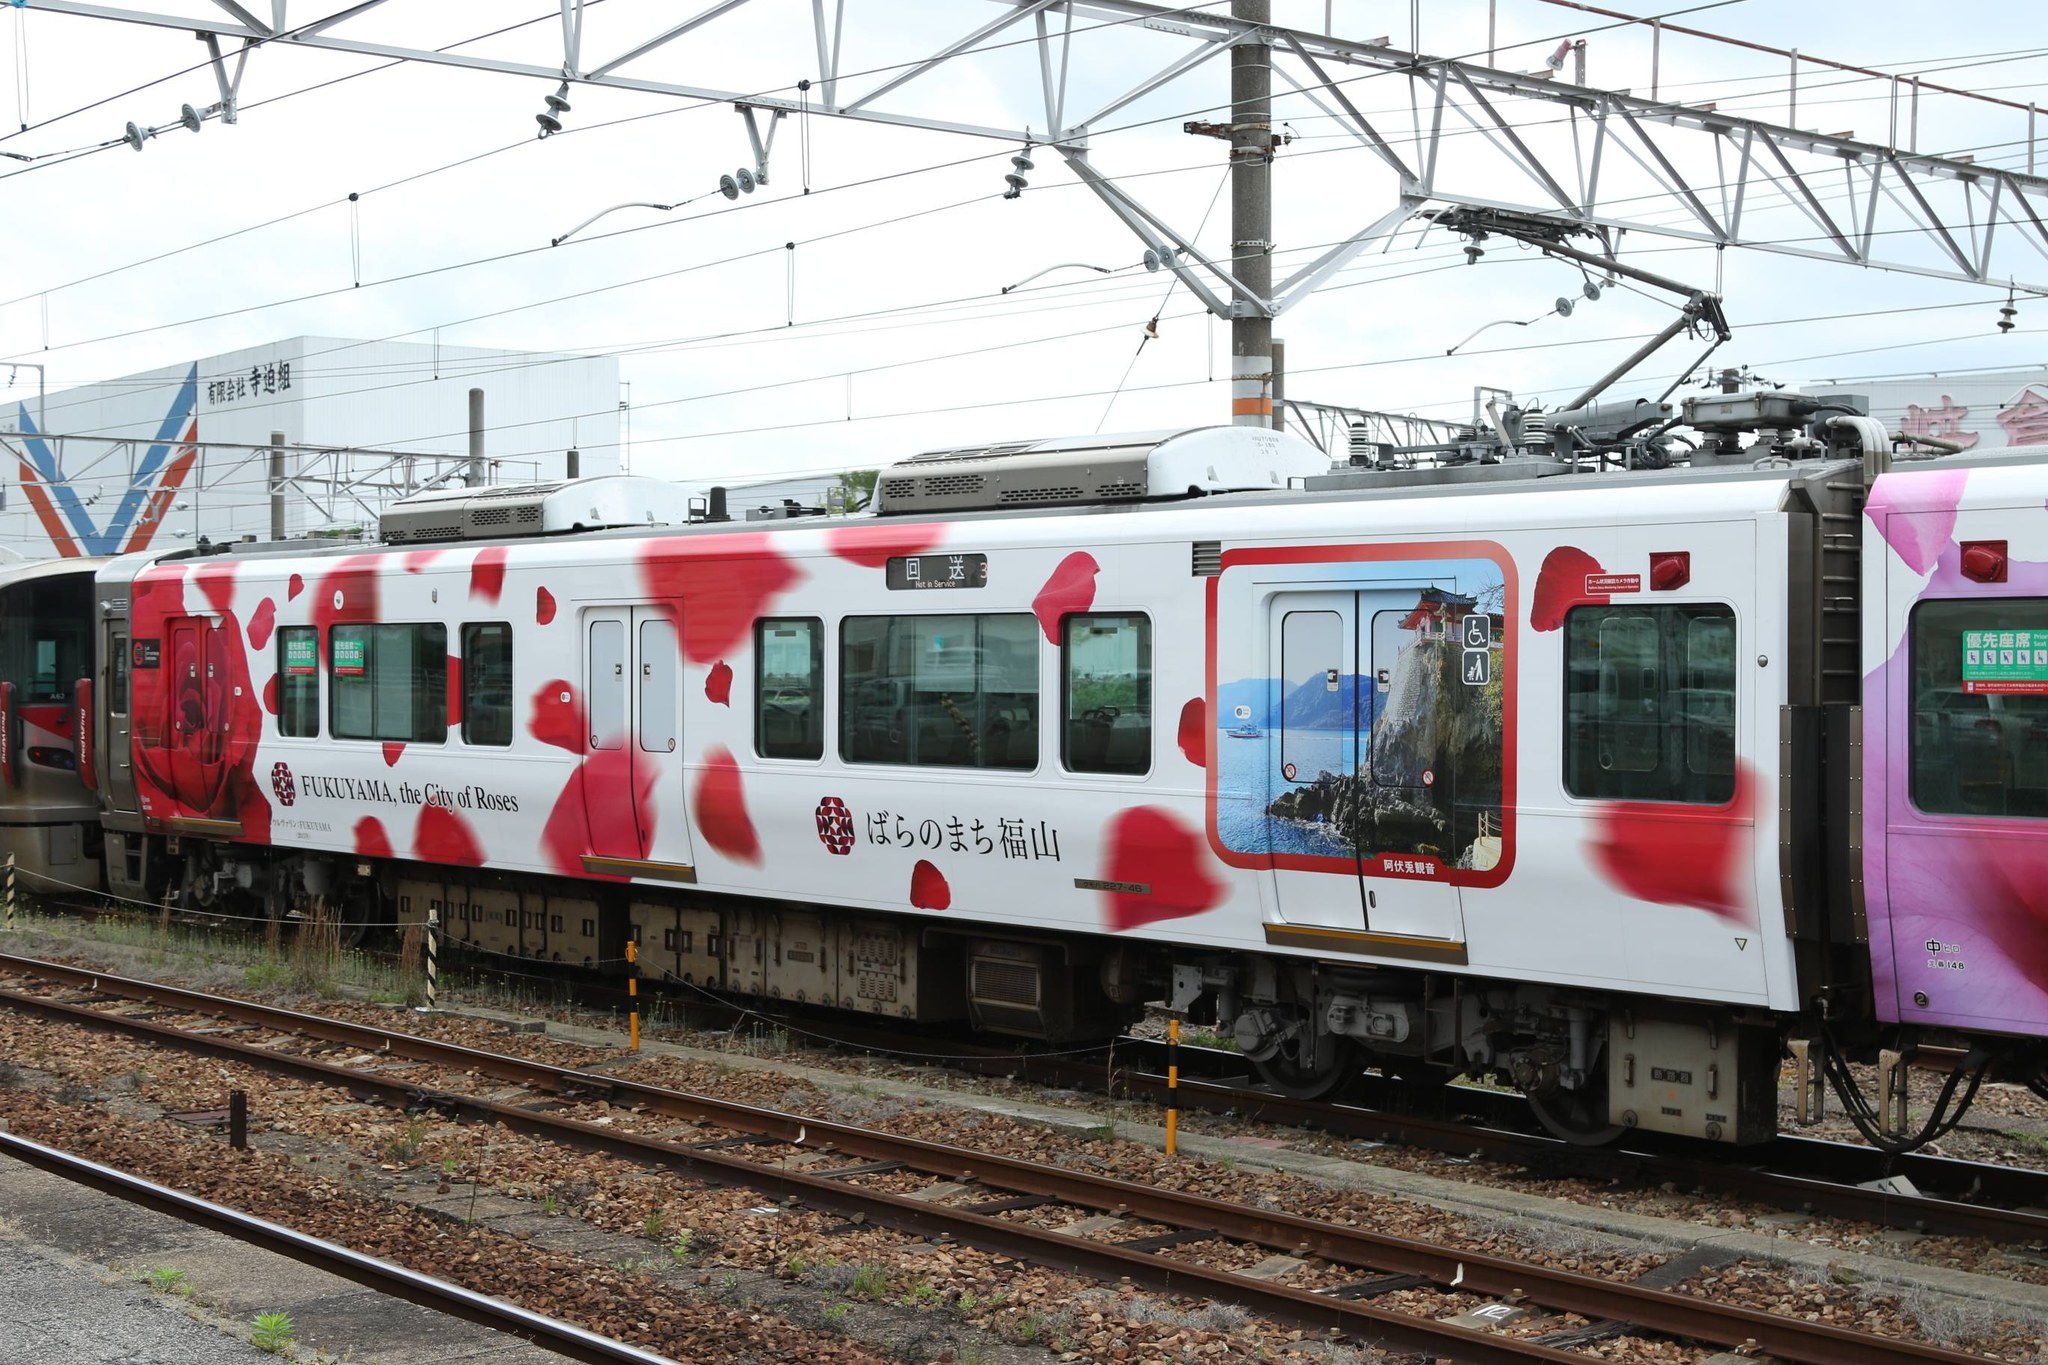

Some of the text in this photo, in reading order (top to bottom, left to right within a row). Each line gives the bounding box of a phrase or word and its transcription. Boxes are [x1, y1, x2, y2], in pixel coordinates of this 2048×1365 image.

[934, 580, 956, 588] Service
[1967, 633, 2030, 648] 優先座席
[301, 775, 519, 813] FUKUYAMA, the City of Roses
[866, 810, 1061, 862] ばらのまち福山
